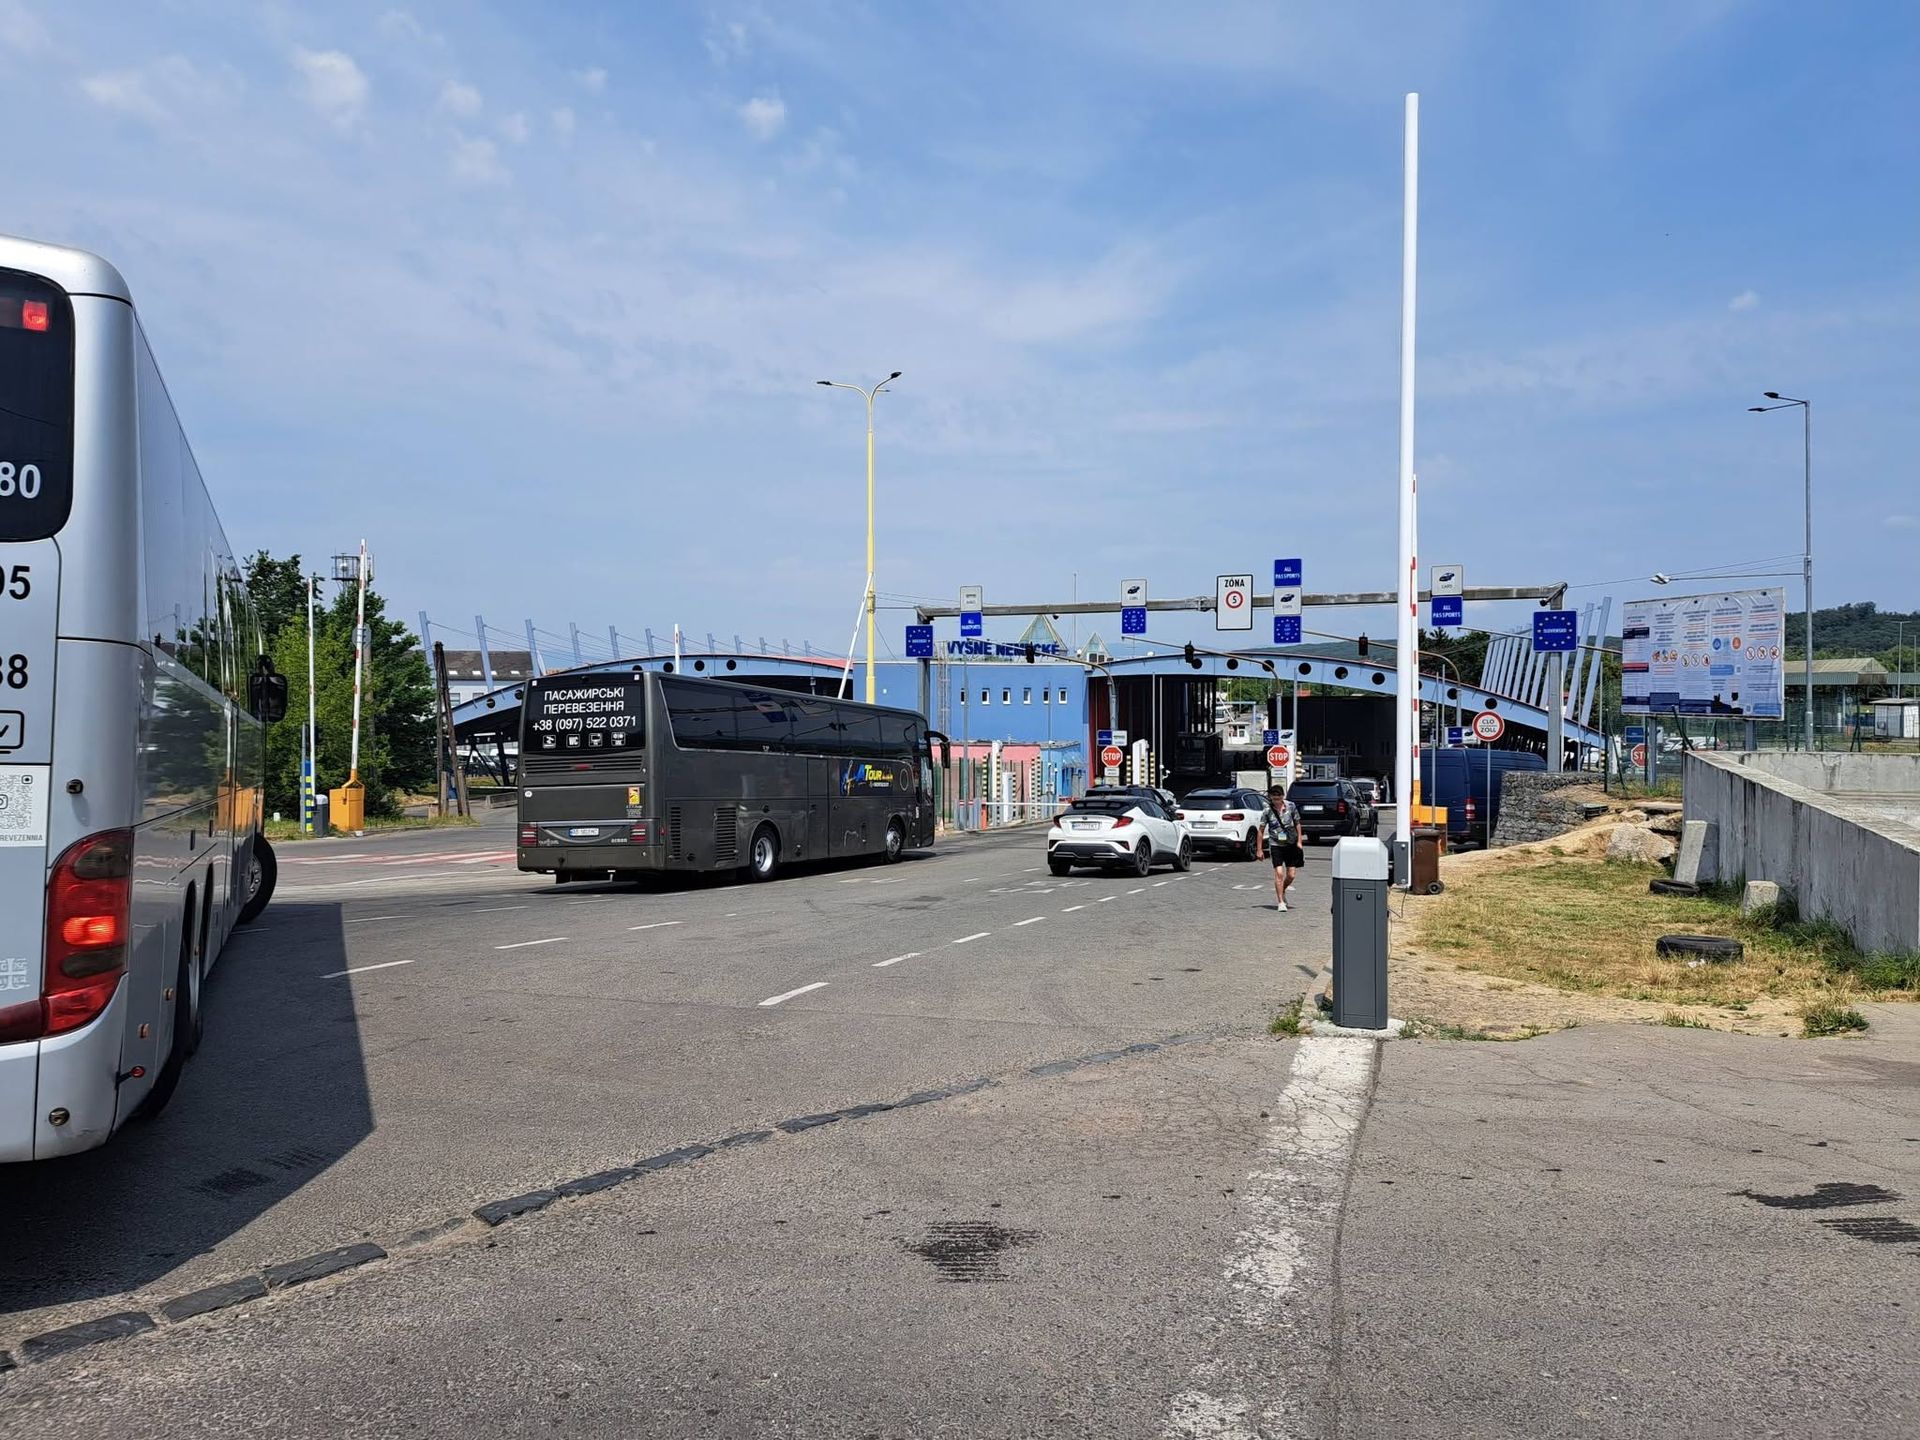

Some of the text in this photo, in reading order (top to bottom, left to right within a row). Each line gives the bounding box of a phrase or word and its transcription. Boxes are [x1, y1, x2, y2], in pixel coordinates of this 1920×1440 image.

[0, 461, 41, 499] 80
[0, 565, 31, 600] 5
[1232, 595, 1238, 604] 5
[0, 653, 29, 690] 8
[544, 687, 624, 701] ПАСАЖИРСЬКІ
[543, 701, 624, 715] ПЕРЕВЕЗЕННЯ
[532, 715, 636, 732] +38 (097) 522 0371
[1103, 752, 1121, 761] STOP
[1269, 752, 1289, 761] STOP
